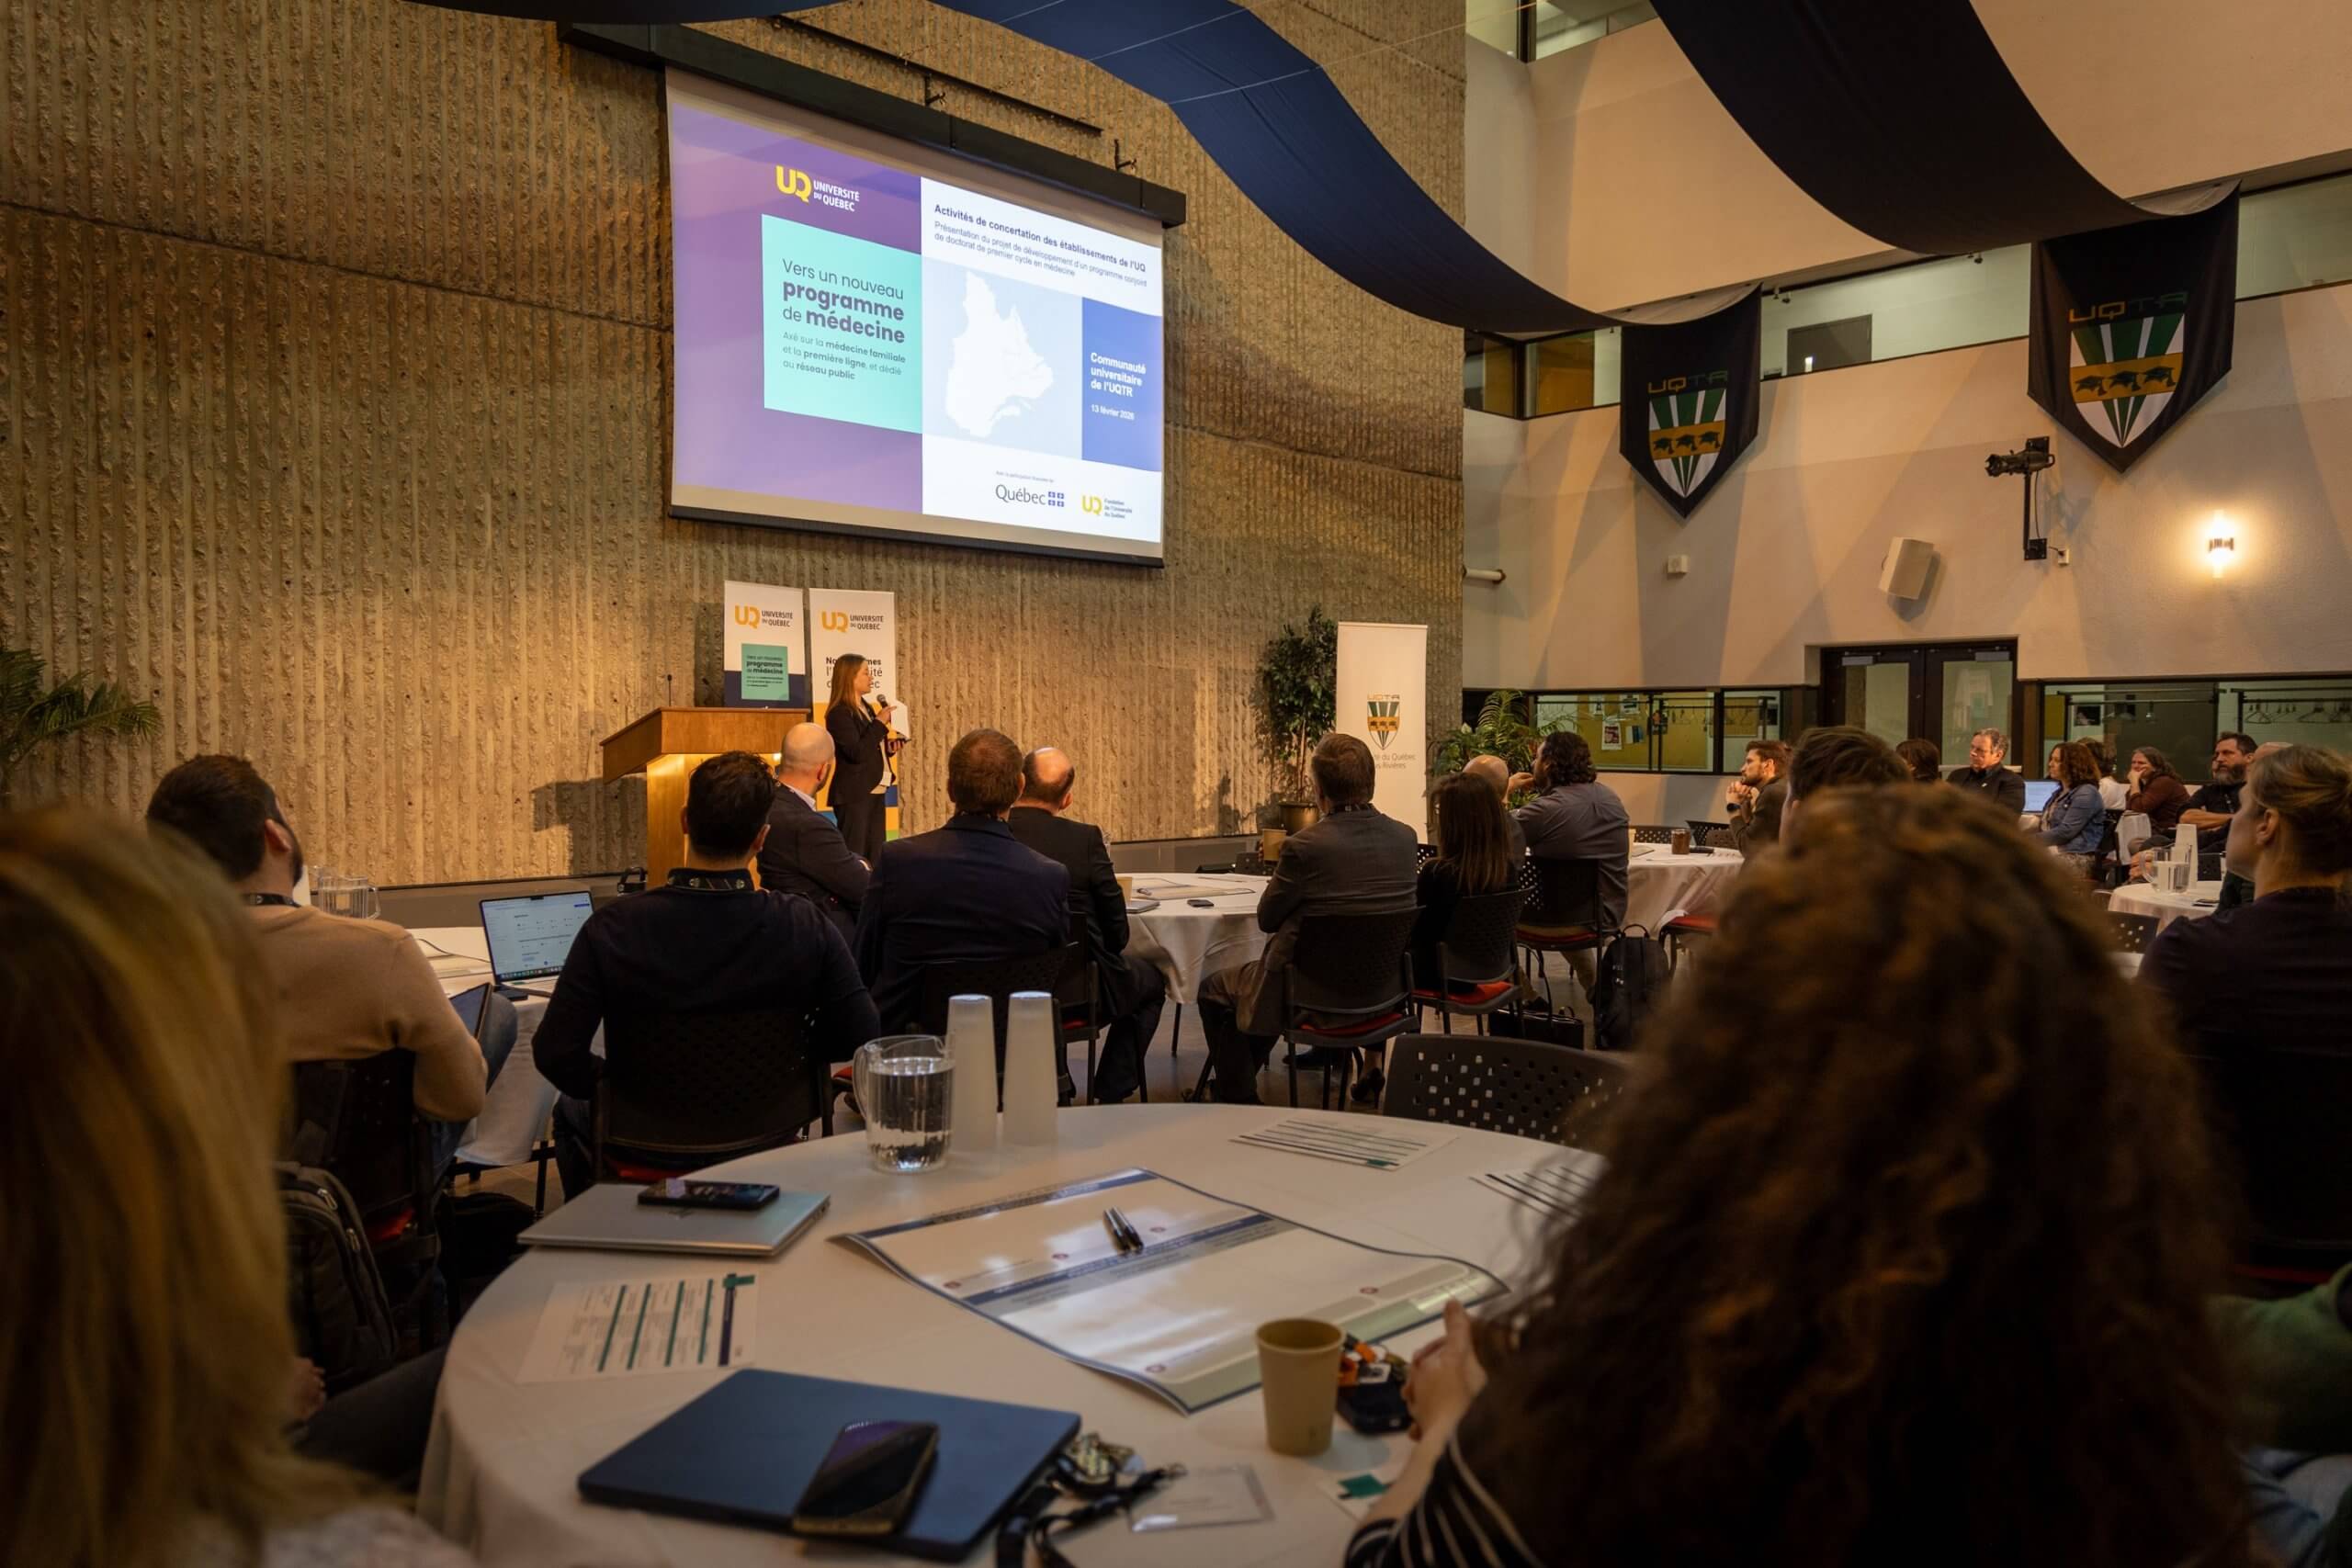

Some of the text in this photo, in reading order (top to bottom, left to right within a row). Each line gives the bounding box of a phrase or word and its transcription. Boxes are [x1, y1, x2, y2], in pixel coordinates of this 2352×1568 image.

[776, 165, 811, 203] UQ
[813, 180, 860, 202] UNIVERSITÉ
[813, 192, 855, 212] DU QUÉBEC
[934, 204, 974, 223] Activités
[976, 216, 987, 226] de
[989, 220, 1041, 243] concertation
[1043, 236, 1057, 247] des
[1060, 240, 1117, 265] établissements
[1119, 257, 1128, 267] de
[934, 220, 979, 241] Présentation
[981, 235, 990, 243] du
[992, 238, 1012, 250] projet
[1012, 243, 1022, 252] de
[1023, 246, 1073, 266] développement
[1089, 265, 1123, 279] programme
[934, 233, 944, 243] de
[945, 235, 975, 250] doctorat
[976, 243, 985, 253] de
[987, 248, 1013, 260] premier
[1014, 254, 1033, 265] cycle
[1044, 261, 1075, 277] médecine
[783, 259, 903, 299] Vers un nouveau
[783, 281, 904, 321] programme
[2069, 291, 2188, 322] UQTR
[783, 306, 905, 344] de médecine
[783, 332, 906, 363] Axé sur la médecine familiale
[783, 345, 791, 354] et
[794, 347, 802, 355] la
[803, 350, 843, 364] première
[878, 364, 902, 375] dédié
[783, 360, 856, 380] au réseau public
[1091, 352, 1147, 375] Communauté
[1091, 367, 1143, 387] universitaire
[1091, 378, 1134, 397] de l'UQTR
[996, 484, 1046, 505] Québec
[1082, 495, 1102, 516] UQ
[735, 604, 761, 629] UQ
[821, 612, 849, 633] UQ
